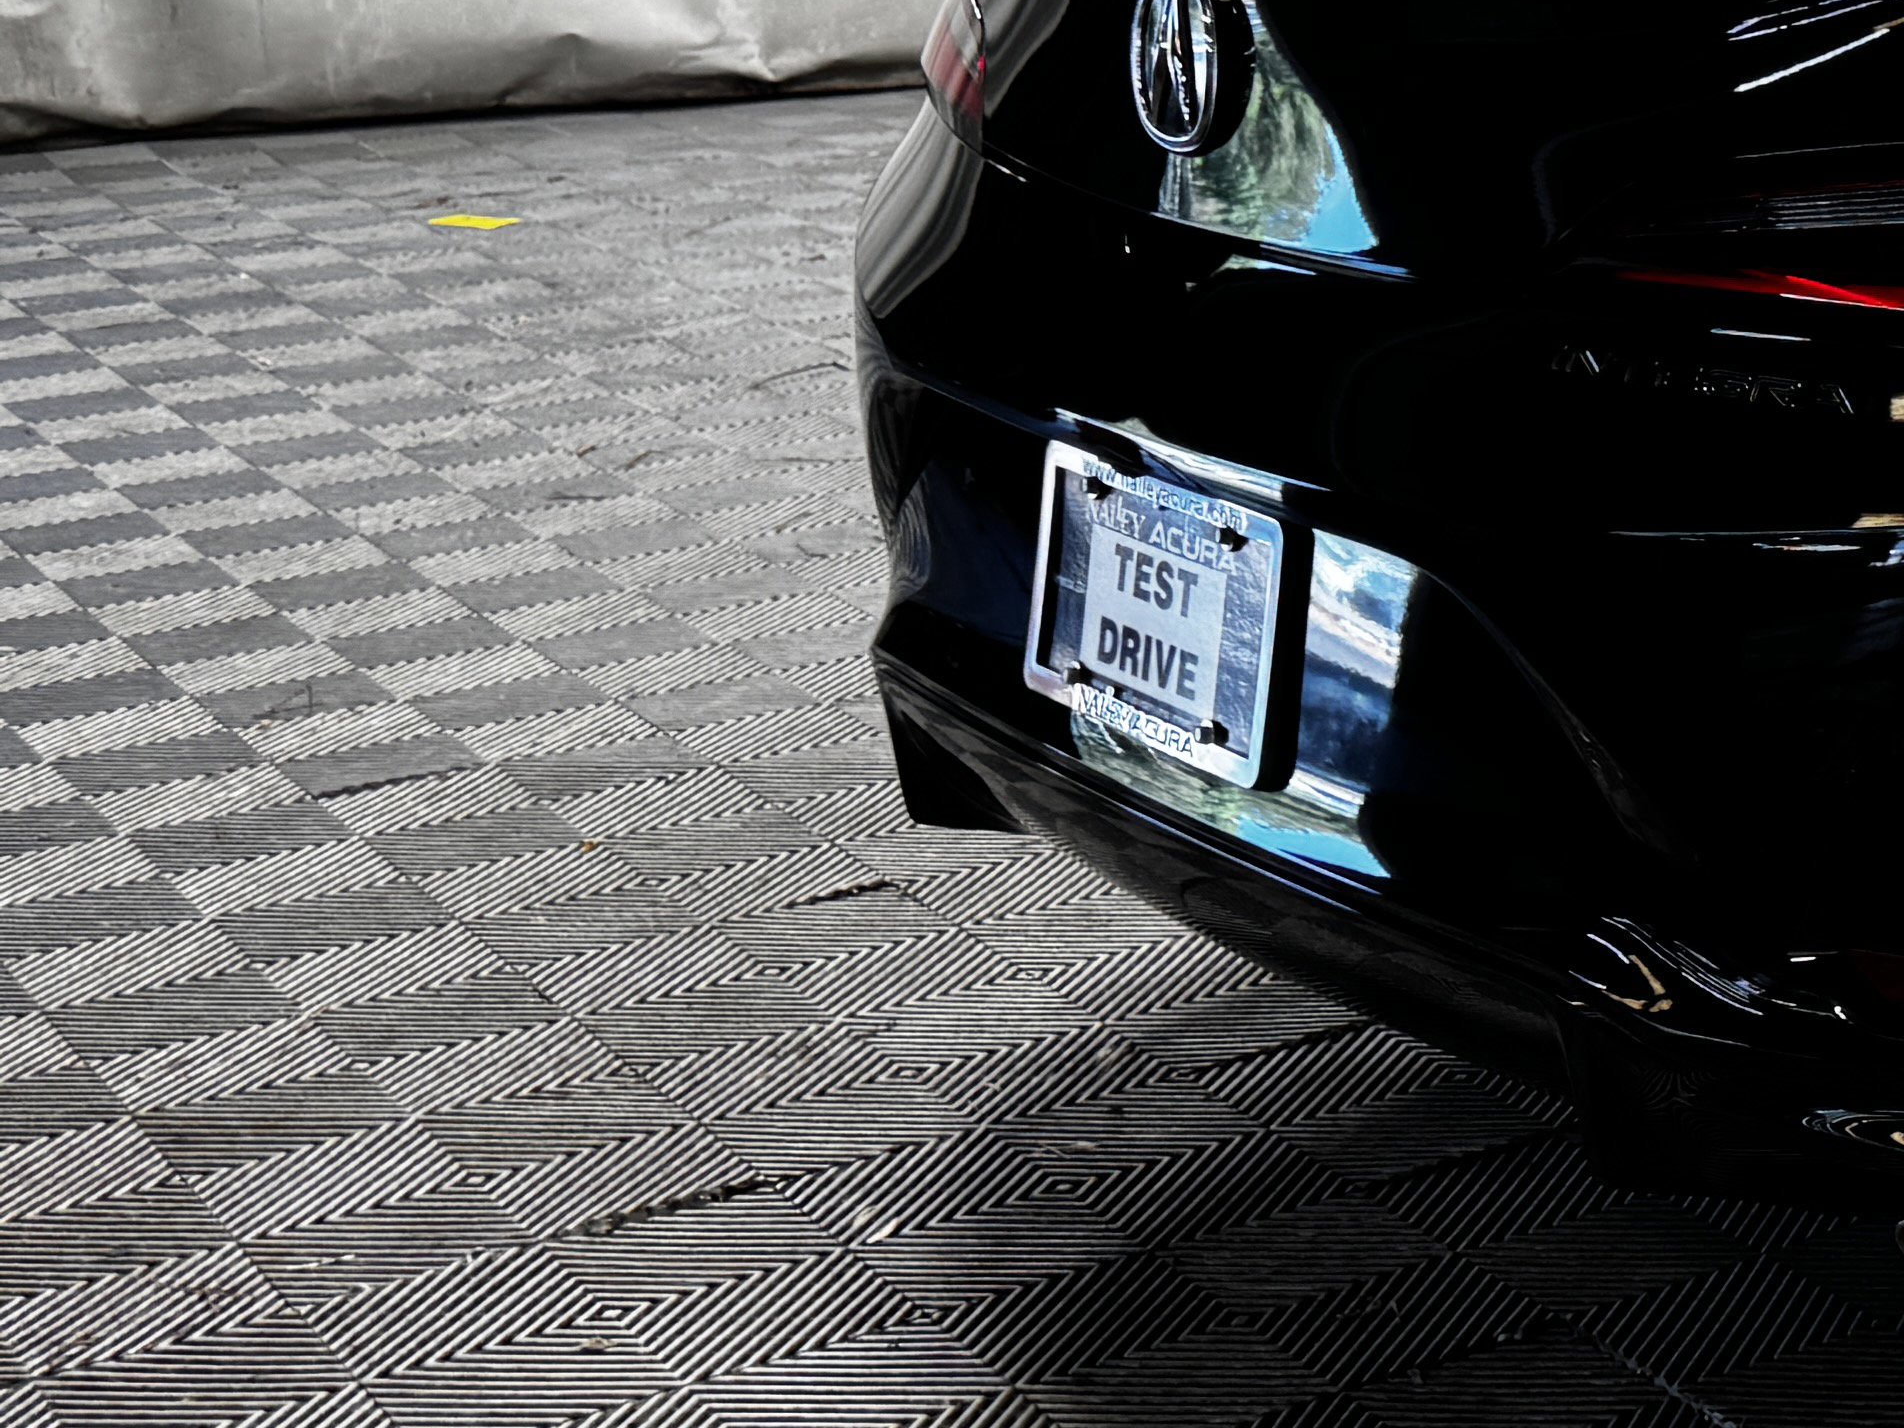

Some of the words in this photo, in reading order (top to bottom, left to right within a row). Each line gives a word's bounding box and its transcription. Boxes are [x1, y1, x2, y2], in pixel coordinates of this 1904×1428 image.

[1114, 542, 1200, 619] TEST
[1148, 520, 1238, 577] ACURA
[1097, 615, 1200, 702] DRIVE
